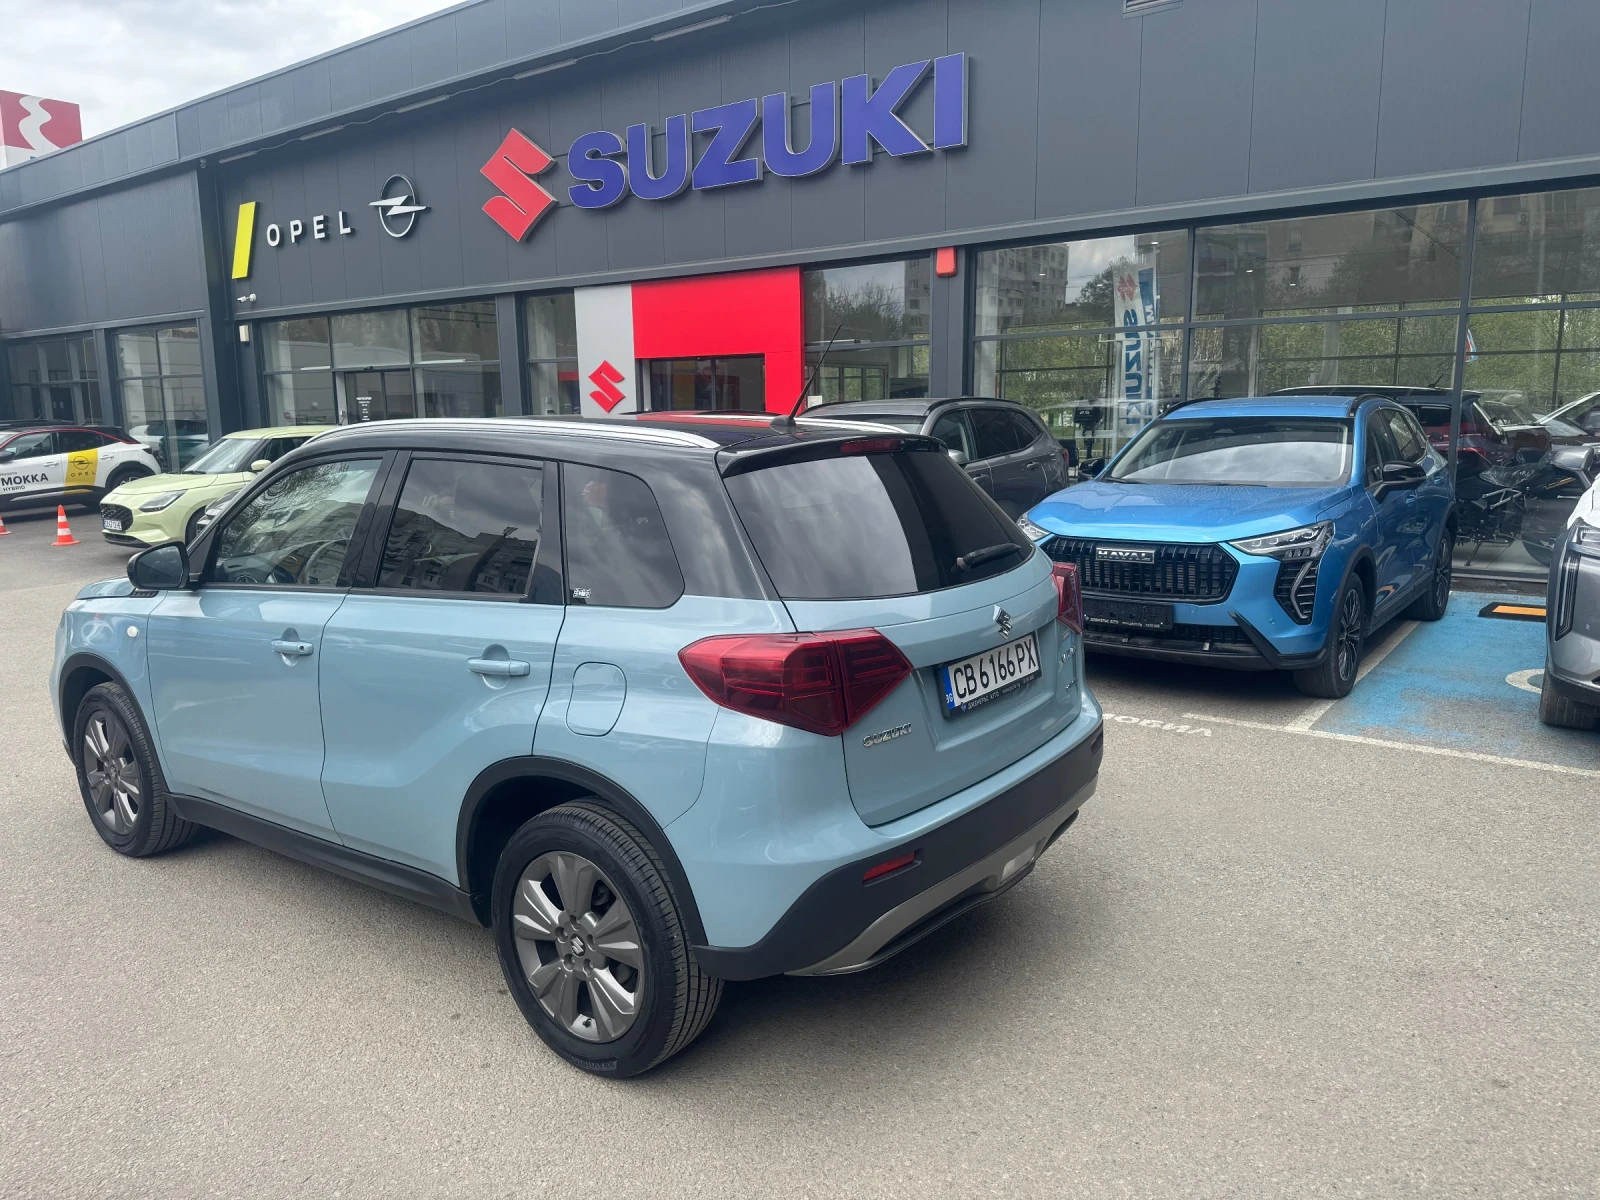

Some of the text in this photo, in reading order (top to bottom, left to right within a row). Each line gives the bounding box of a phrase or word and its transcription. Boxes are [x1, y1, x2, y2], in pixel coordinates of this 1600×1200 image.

[567, 51, 969, 209] SUZUKI
[265, 210, 352, 247] OPEL
[1, 472, 49, 486] MOKKA
[1098, 550, 1151, 562] HAVAL
[953, 665, 977, 699] CB
[979, 647, 1016, 688] 6166
[1015, 640, 1036, 674] PX
[862, 722, 912, 748] SUZUKI
